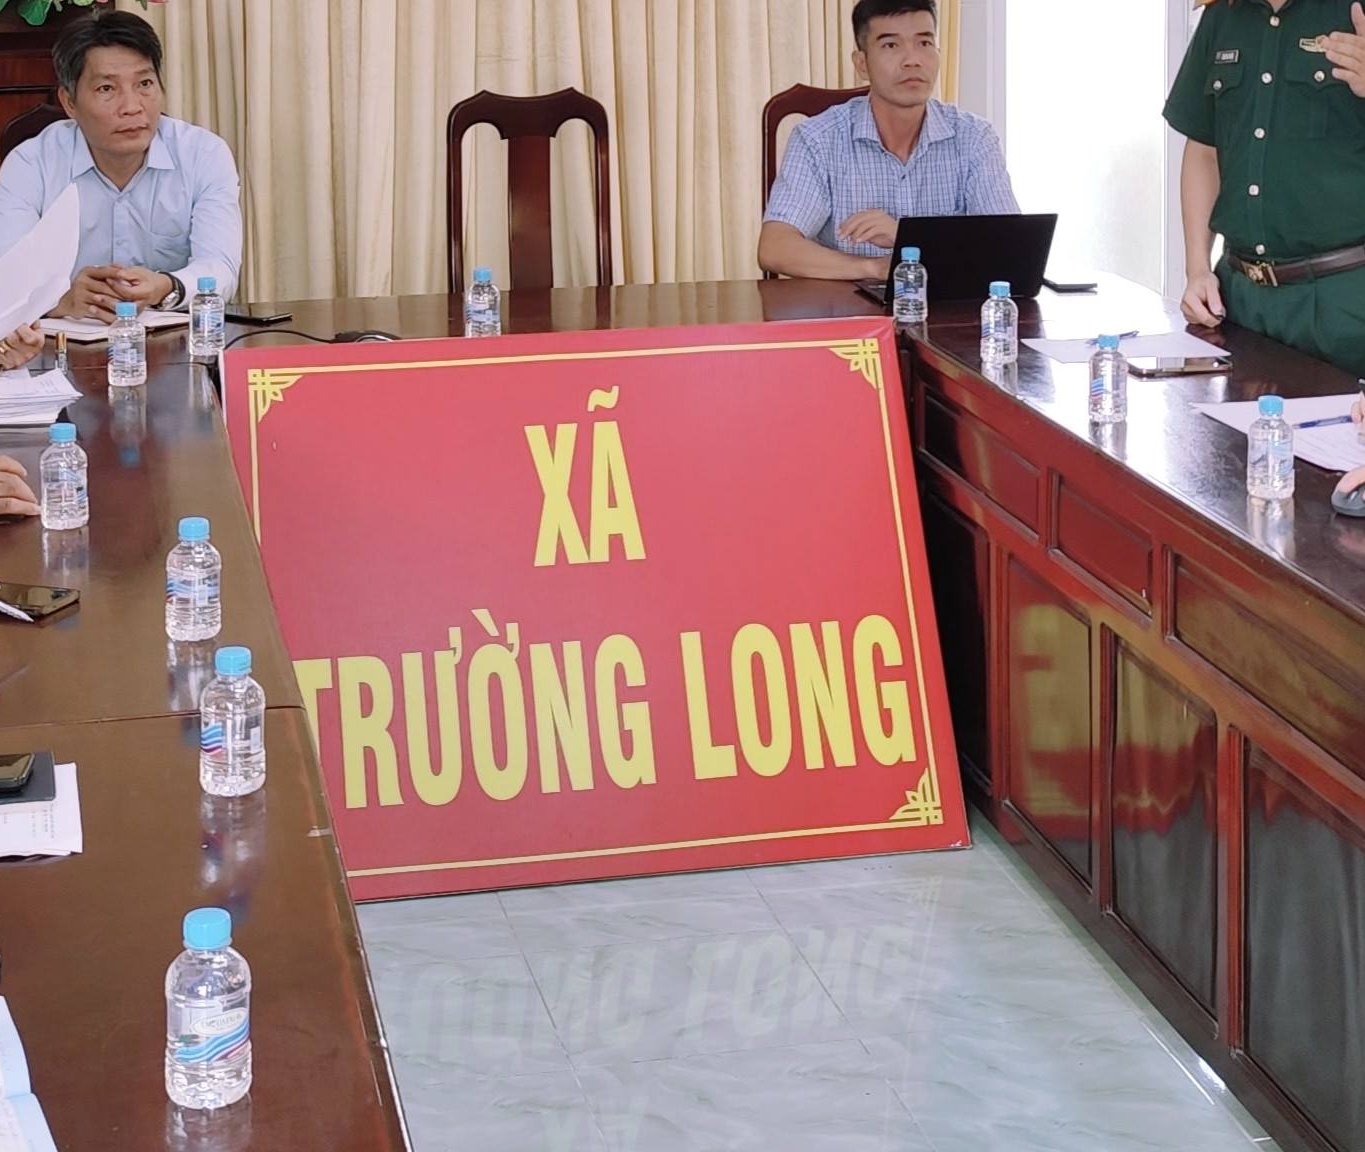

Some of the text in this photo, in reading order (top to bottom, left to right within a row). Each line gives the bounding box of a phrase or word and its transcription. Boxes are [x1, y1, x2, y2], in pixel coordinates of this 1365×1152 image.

[524, 385, 646, 567] XÃ
[292, 609, 917, 809] TRƯỜNG LONG
